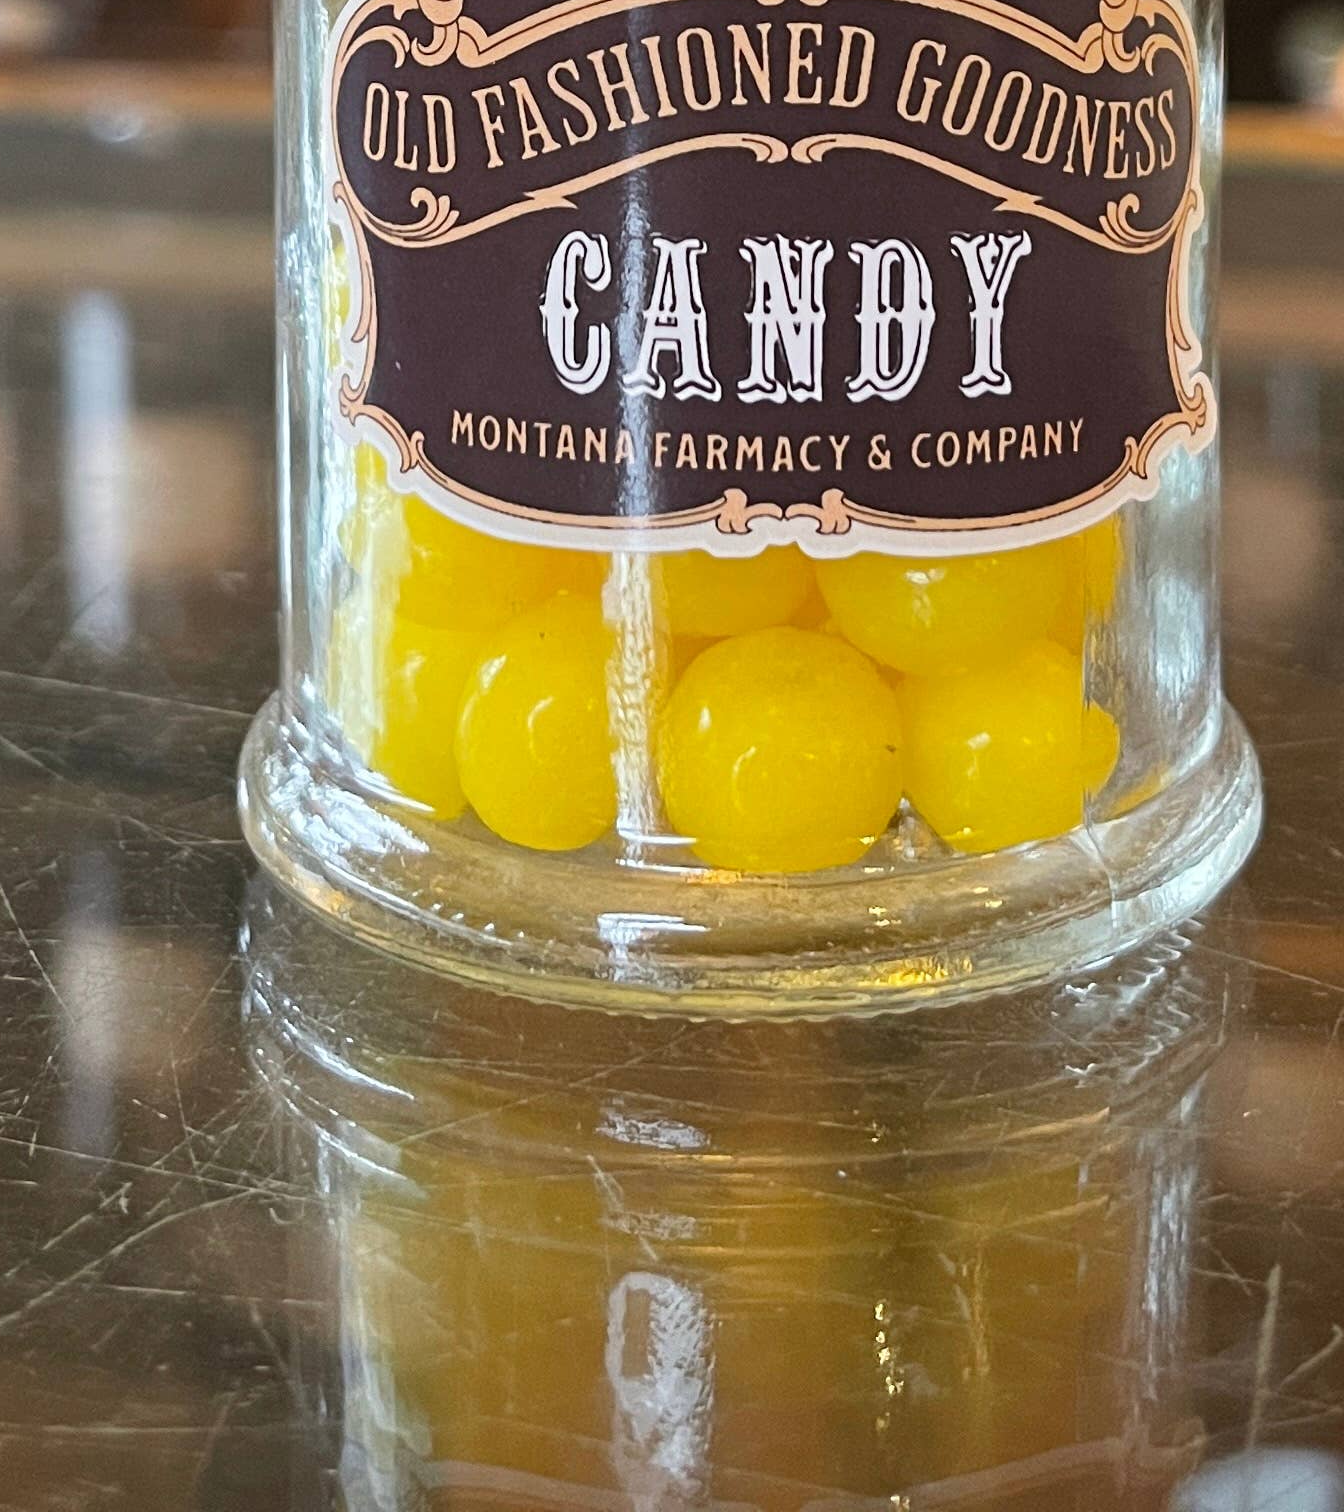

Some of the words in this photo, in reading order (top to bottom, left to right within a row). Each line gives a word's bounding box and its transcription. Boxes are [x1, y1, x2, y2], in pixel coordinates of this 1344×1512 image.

[364, 82, 457, 174] OLD
[472, 22, 875, 169] FASHIONED
[897, 41, 1178, 180] GOODNESS
[539, 231, 1032, 403] CANDY
[451, 410, 635, 465] MONTANA
[655, 432, 849, 472] FARMACY
[869, 434, 893, 471] &
[911, 419, 1083, 468] COMPANY
